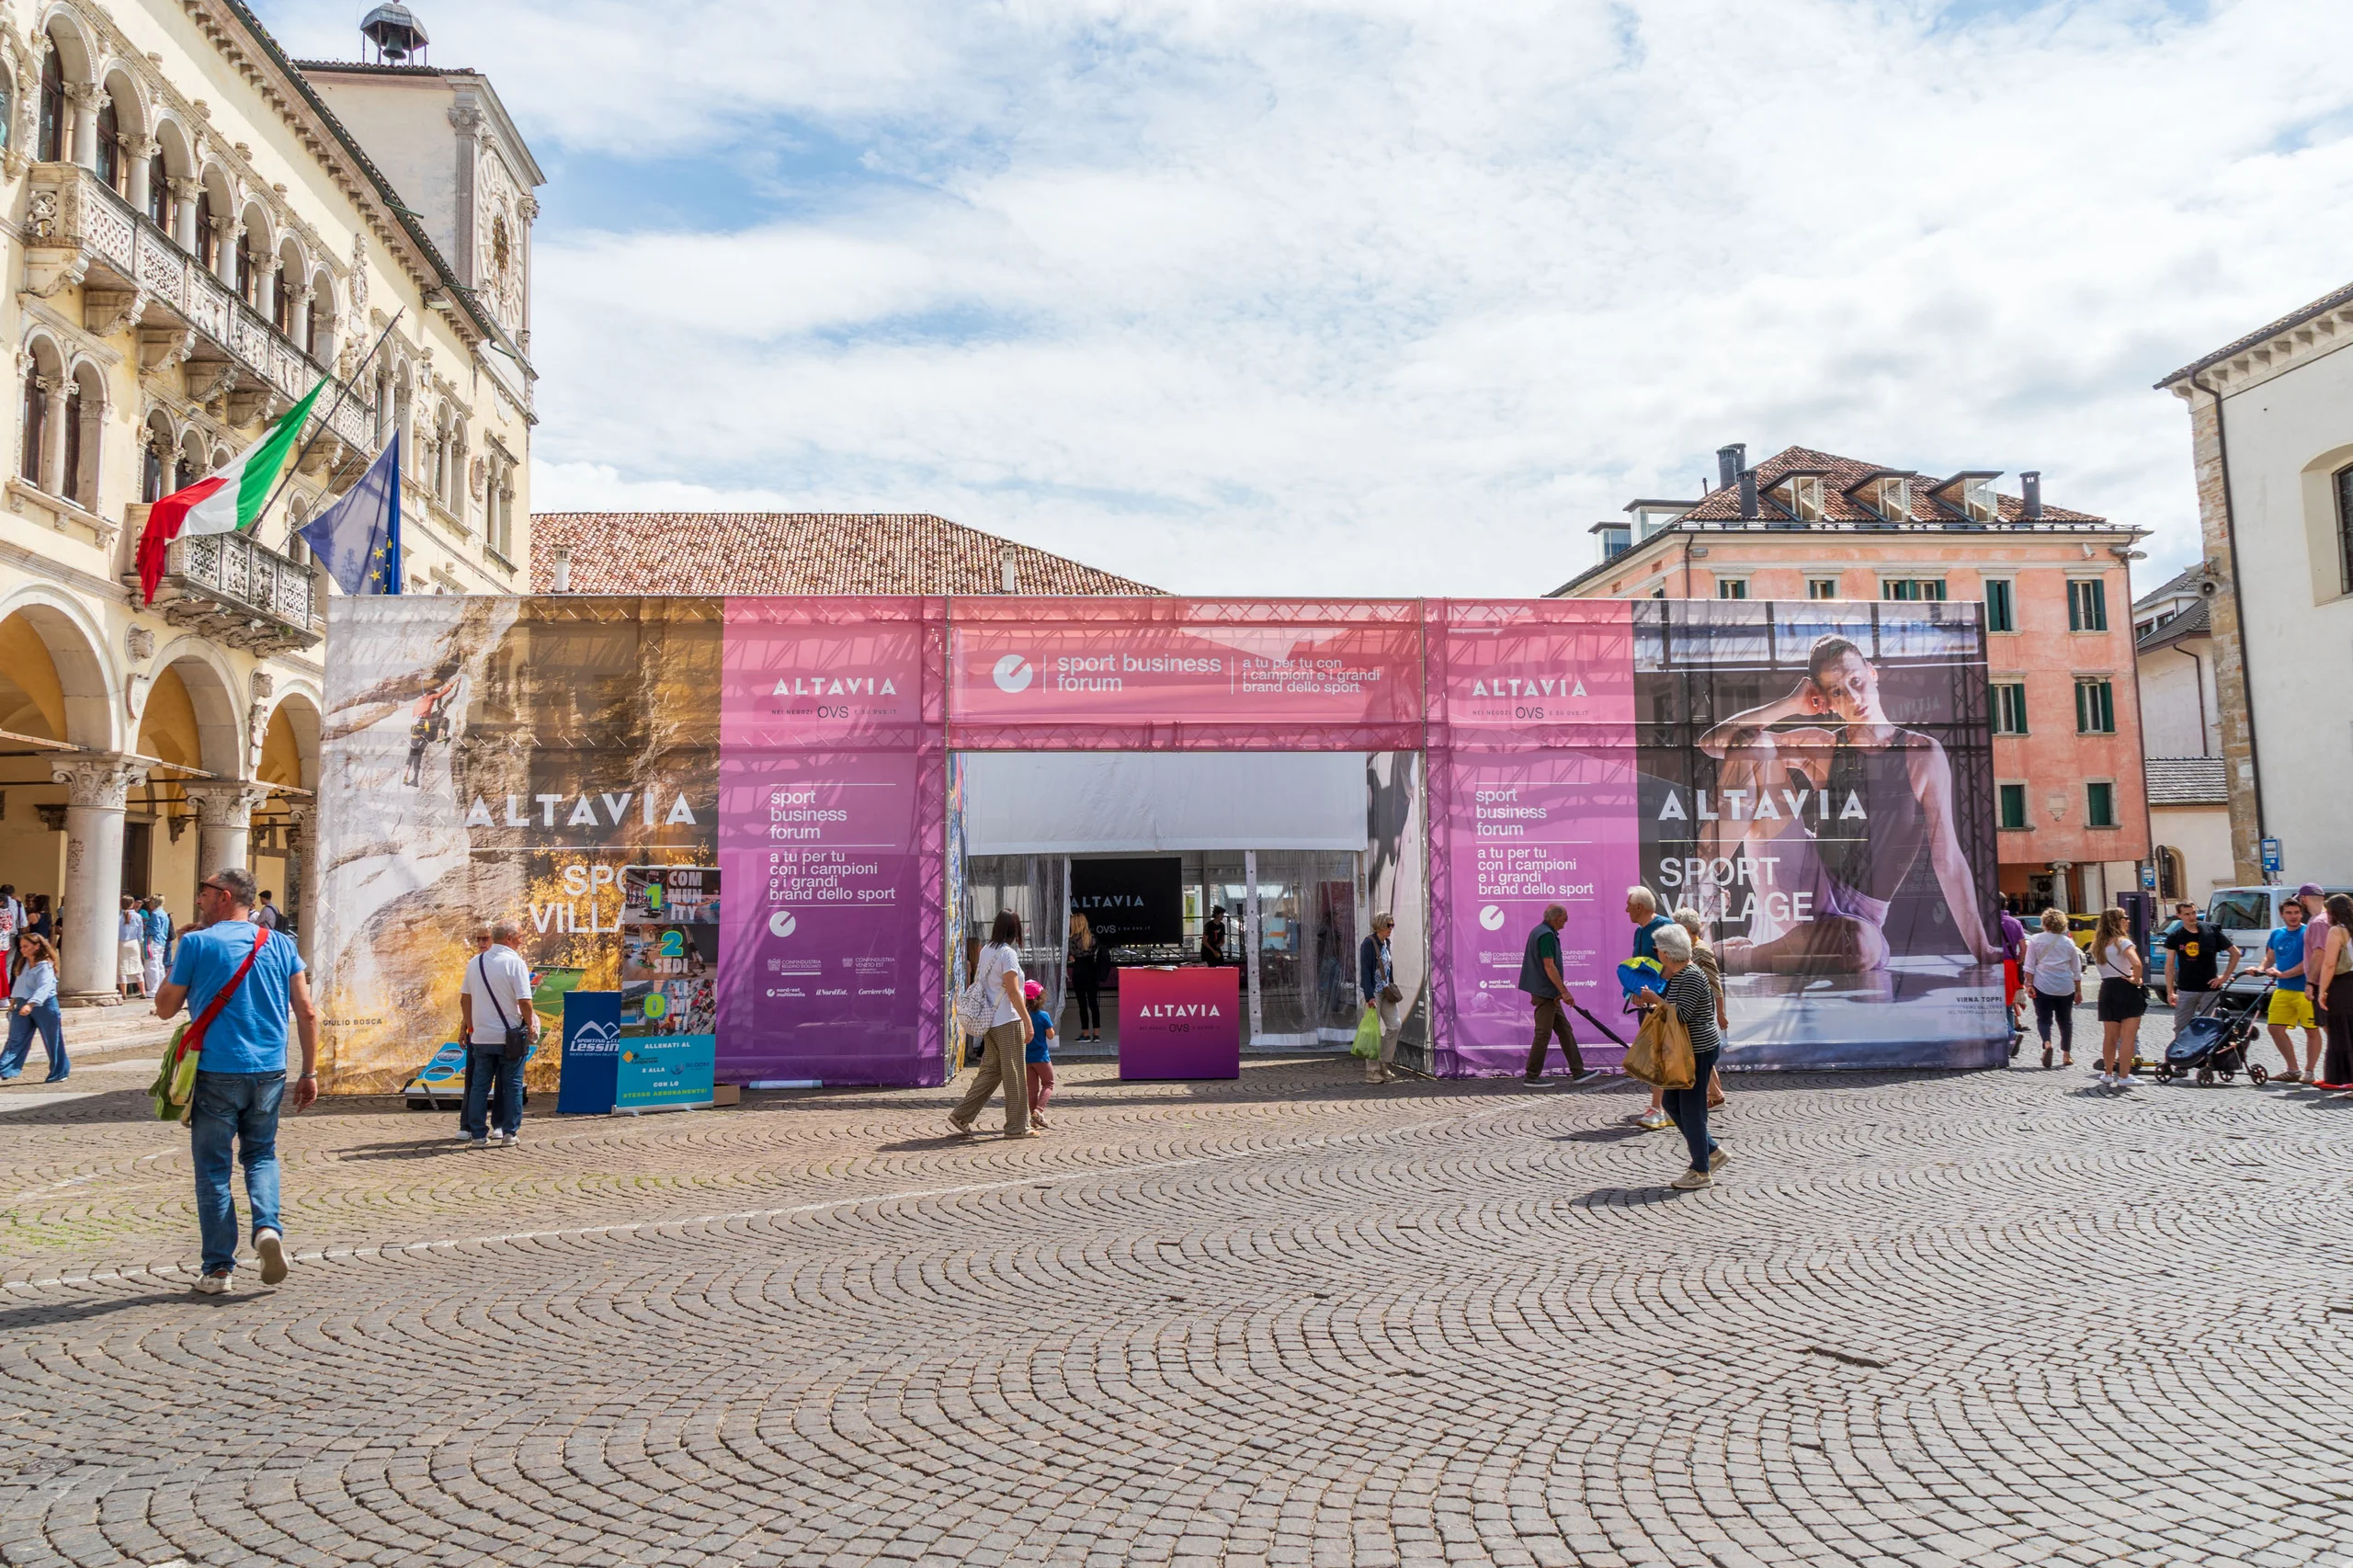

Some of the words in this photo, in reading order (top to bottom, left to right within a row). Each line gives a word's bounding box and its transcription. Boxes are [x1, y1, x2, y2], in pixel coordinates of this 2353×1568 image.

[1057, 653, 1116, 675] sport
[1123, 653, 1222, 672] business
[1243, 659, 1251, 668] a
[1256, 657, 1268, 668] tu
[1273, 659, 1295, 670] per
[1299, 657, 1313, 668] tu
[1316, 659, 1342, 668] con
[1057, 675, 1122, 692] forum
[1243, 669, 1246, 680] i
[1250, 669, 1313, 683] campioni
[1317, 672, 1325, 680] e
[1330, 669, 1333, 680] i
[1337, 669, 1380, 683] grandi
[773, 678, 897, 695] ALTAVIA
[1243, 681, 1282, 693] brand
[1287, 681, 1320, 692] dello
[1324, 682, 1360, 695] sport
[1472, 679, 1587, 697] ALTAVIA
[818, 706, 849, 719] OVS
[1516, 707, 1544, 719] OVS
[770, 790, 816, 807] sport
[1475, 789, 1518, 805] sport
[463, 792, 697, 827] ALTAVIA
[1476, 805, 1547, 818] business
[1658, 789, 1868, 821] ALTAVIA
[770, 807, 847, 822] business
[769, 824, 821, 839] forum
[1476, 822, 1523, 835] forum
[769, 853, 779, 862] a
[783, 851, 798, 862] tu
[802, 853, 826, 865] per
[831, 851, 845, 862] tu
[1478, 849, 1486, 858] a
[1490, 847, 1504, 858] tu
[1507, 848, 1530, 860] per
[1533, 846, 1546, 858] tu
[769, 865, 797, 875] con
[802, 862, 805, 874] i
[811, 862, 878, 877] campioni
[1478, 861, 1504, 870] con
[1508, 858, 1511, 869] i
[1516, 858, 1576, 872] campioni
[1659, 858, 1780, 887] SPORT
[668, 871, 702, 886] COM
[769, 878, 779, 888] e
[783, 875, 787, 887] i
[791, 875, 837, 890] grandi
[1478, 873, 1486, 882] e
[1491, 871, 1494, 882] i
[1499, 870, 1540, 885] grandi
[644, 882, 662, 910] 1
[668, 889, 702, 903] MUN
[769, 888, 813, 901] brand
[817, 888, 853, 900] dello
[858, 888, 895, 902] sport
[1479, 883, 1518, 894] brand
[1522, 882, 1555, 894] dello
[1559, 883, 1594, 897] sport
[1071, 895, 1144, 908] ALTAVIA
[1660, 892, 1814, 923] VILLAGE
[529, 903, 625, 934] VILL
[671, 905, 698, 920] ITY
[1097, 925, 1116, 934] OVS
[660, 930, 683, 957] 2
[654, 959, 688, 973] SEDI
[1140, 1005, 1221, 1017] ALTAVIA
[1169, 1024, 1189, 1032] OVS
[570, 1040, 620, 1051] Lessin
